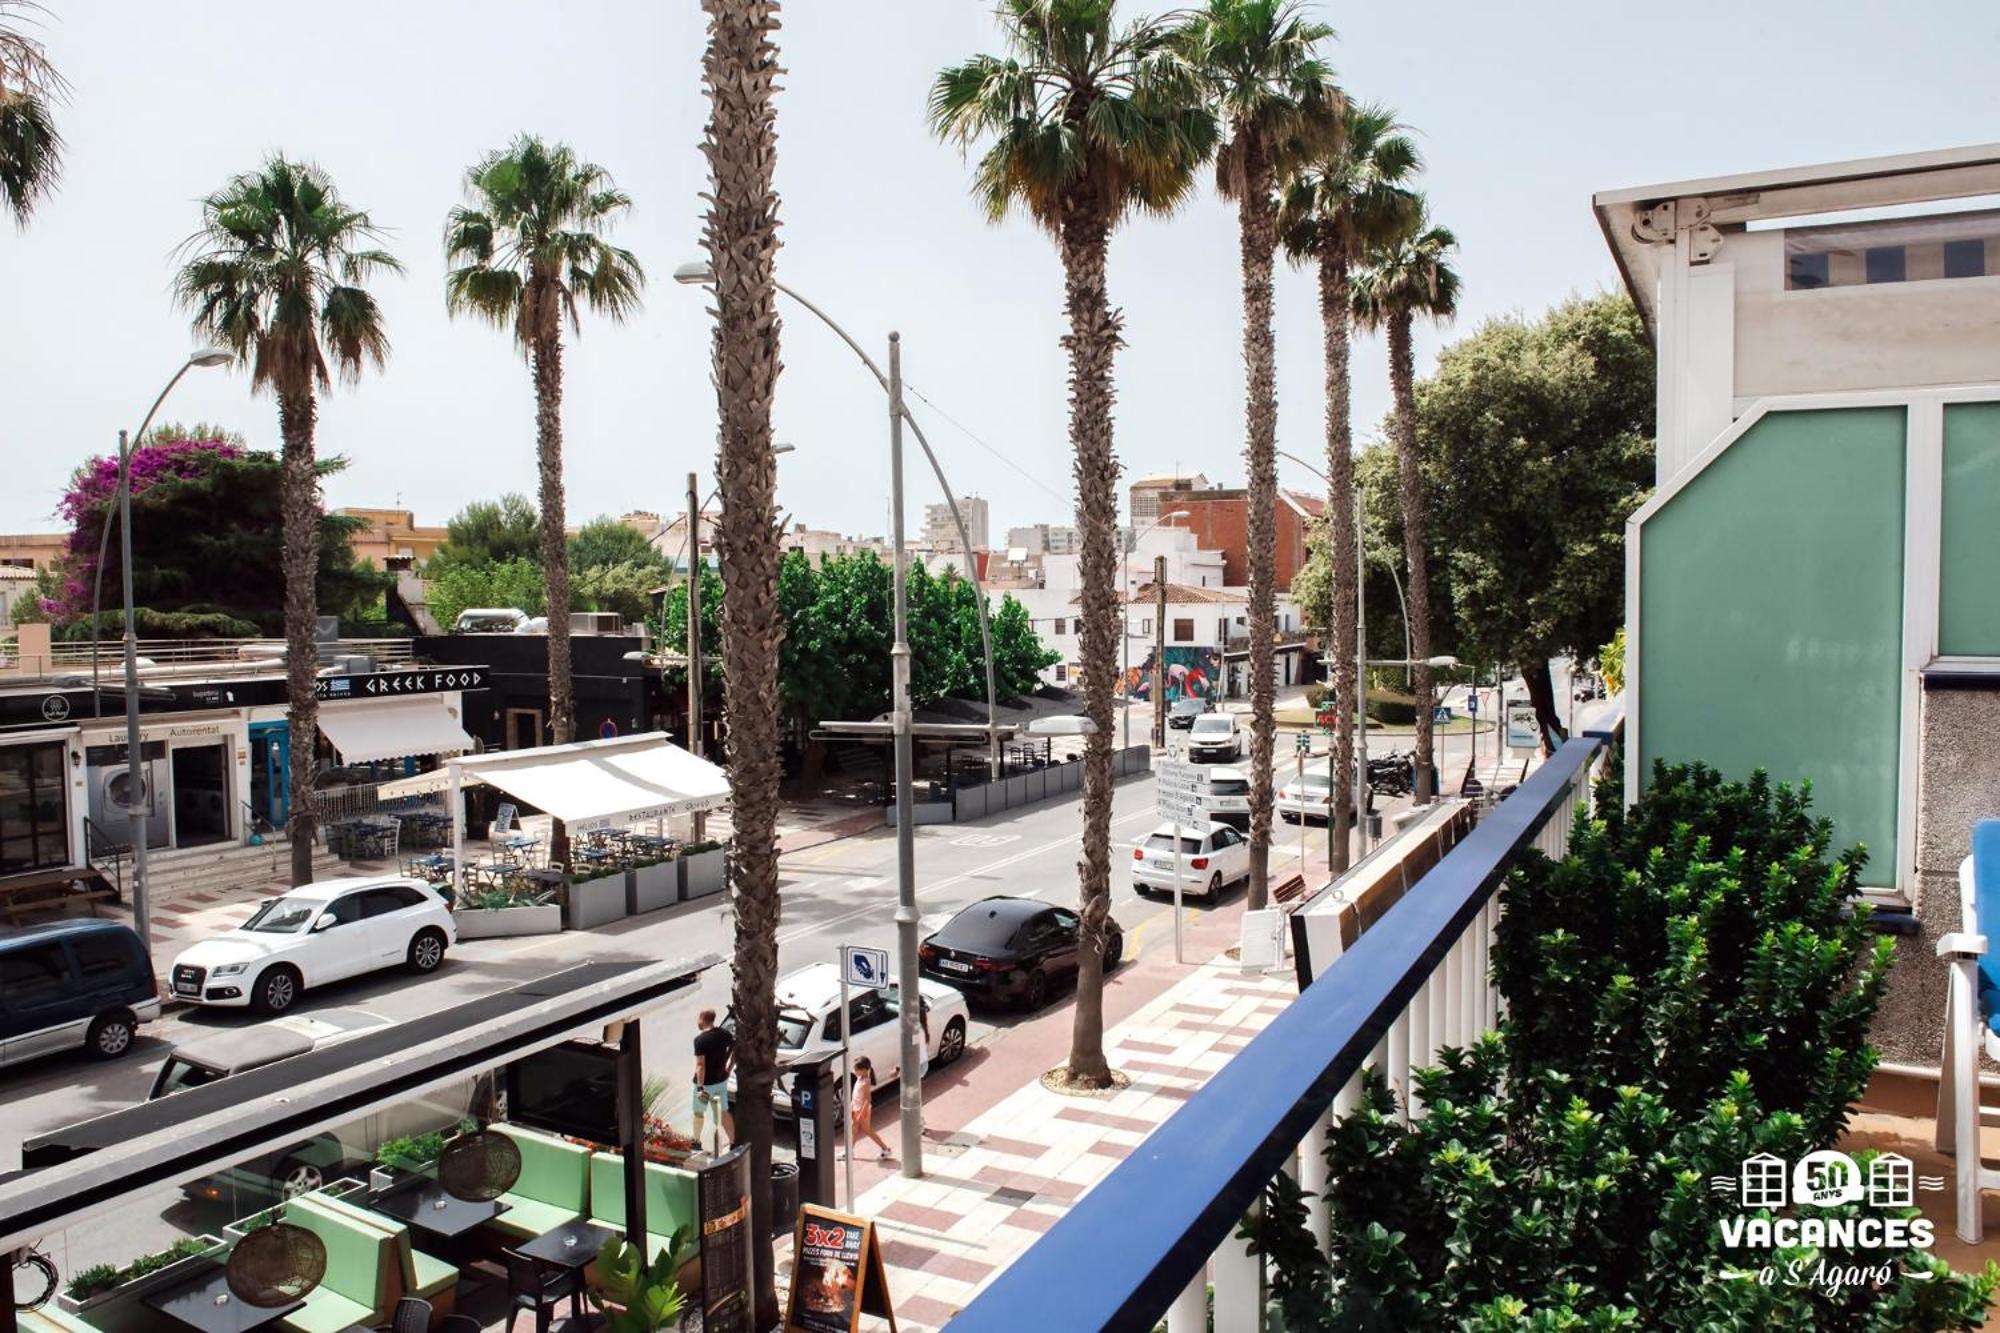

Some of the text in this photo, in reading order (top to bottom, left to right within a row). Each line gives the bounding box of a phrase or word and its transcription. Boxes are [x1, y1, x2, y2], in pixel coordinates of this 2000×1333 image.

[366, 672, 481, 693] GREEK FOOD
[109, 725, 220, 744] Laury Autorentat
[801, 1090, 811, 1105] P
[804, 1223, 846, 1250] 3x2
